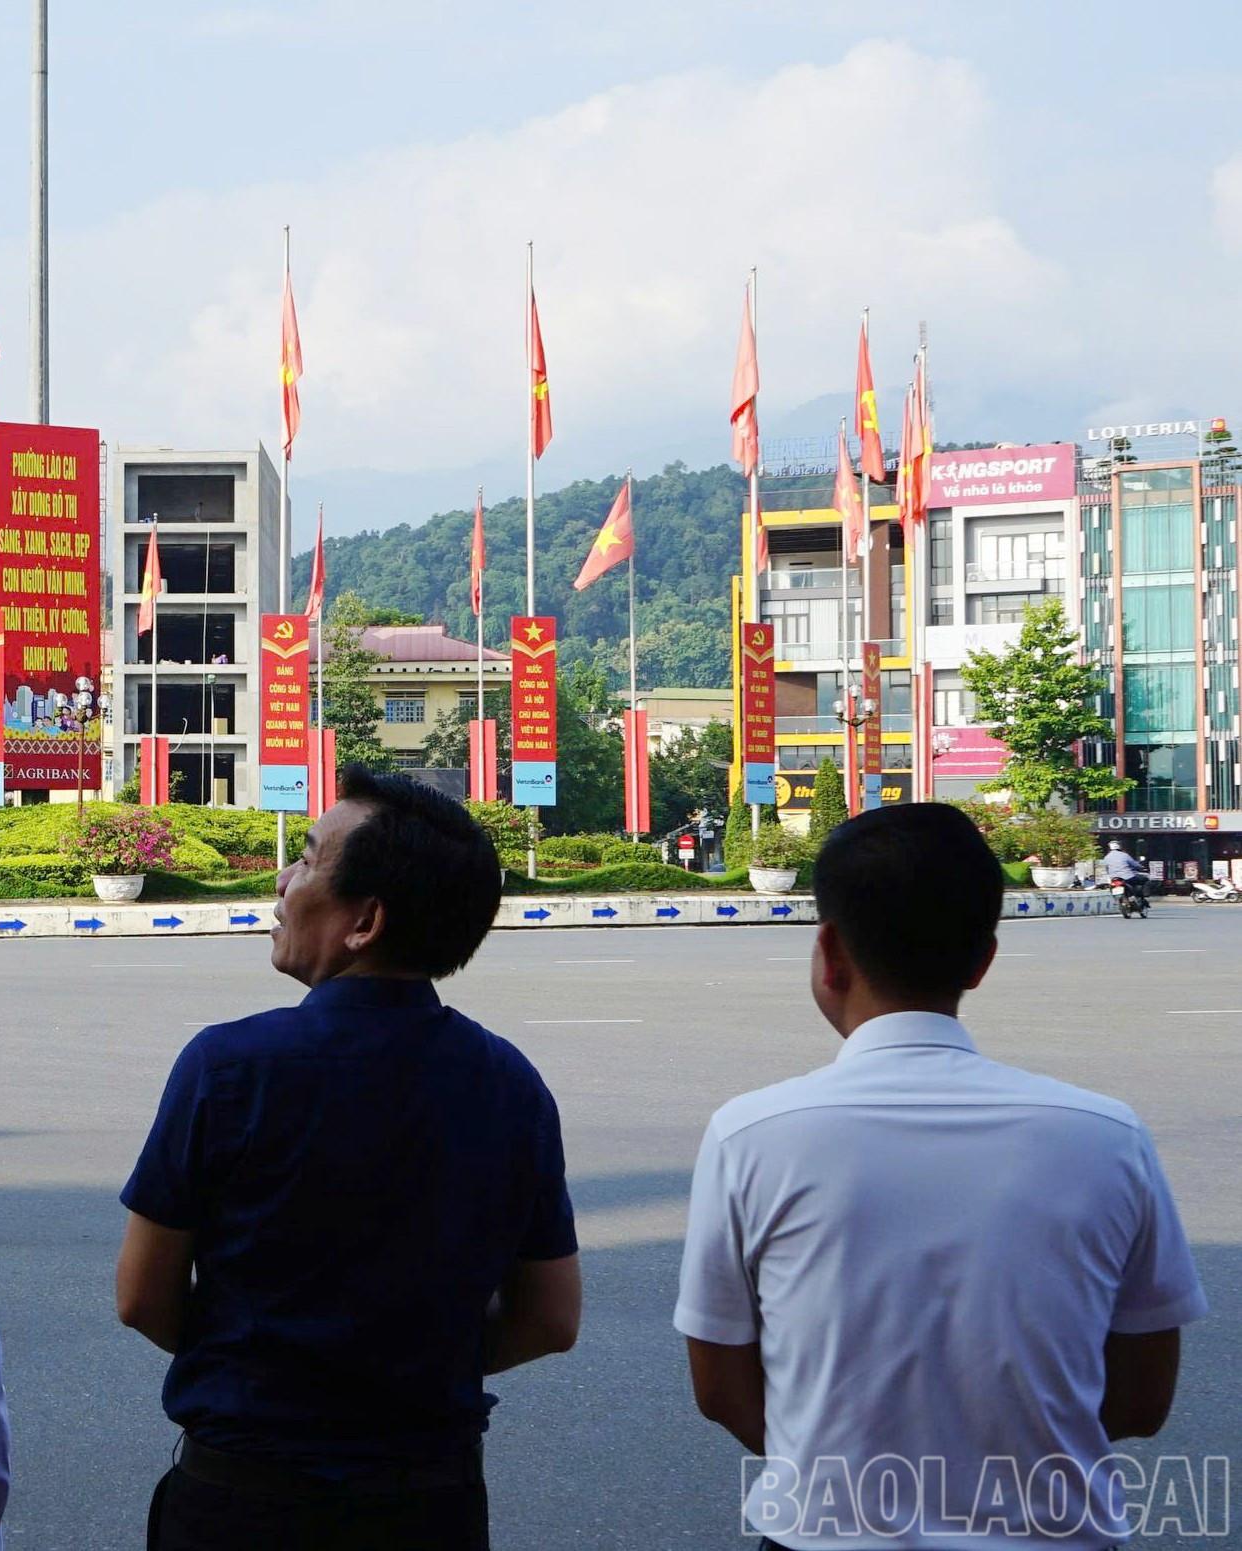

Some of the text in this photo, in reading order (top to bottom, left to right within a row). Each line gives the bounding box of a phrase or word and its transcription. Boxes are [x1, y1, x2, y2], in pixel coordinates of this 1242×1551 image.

[1087, 420, 1199, 441] LOTTERIA
[12, 447, 77, 480] PHƯỜNG LÀO CAI
[992, 482, 1006, 495] là
[11, 486, 78, 525] XÂY DỰNG ĐÔ THỊ
[24, 530, 49, 558] XANH,
[50, 531, 74, 562] SẠCH,
[75, 533, 90, 563] ĐẸP
[2, 563, 87, 599] CON NGƯỜI VĂN MINH,
[0, 598, 90, 638] HÂN THIỆN, KỶ CƯƠNG,
[23, 642, 68, 677] HẠNH PHÚC
[17, 767, 91, 780] AGRIBANK
[1097, 816, 1197, 829] LOTTERIA
